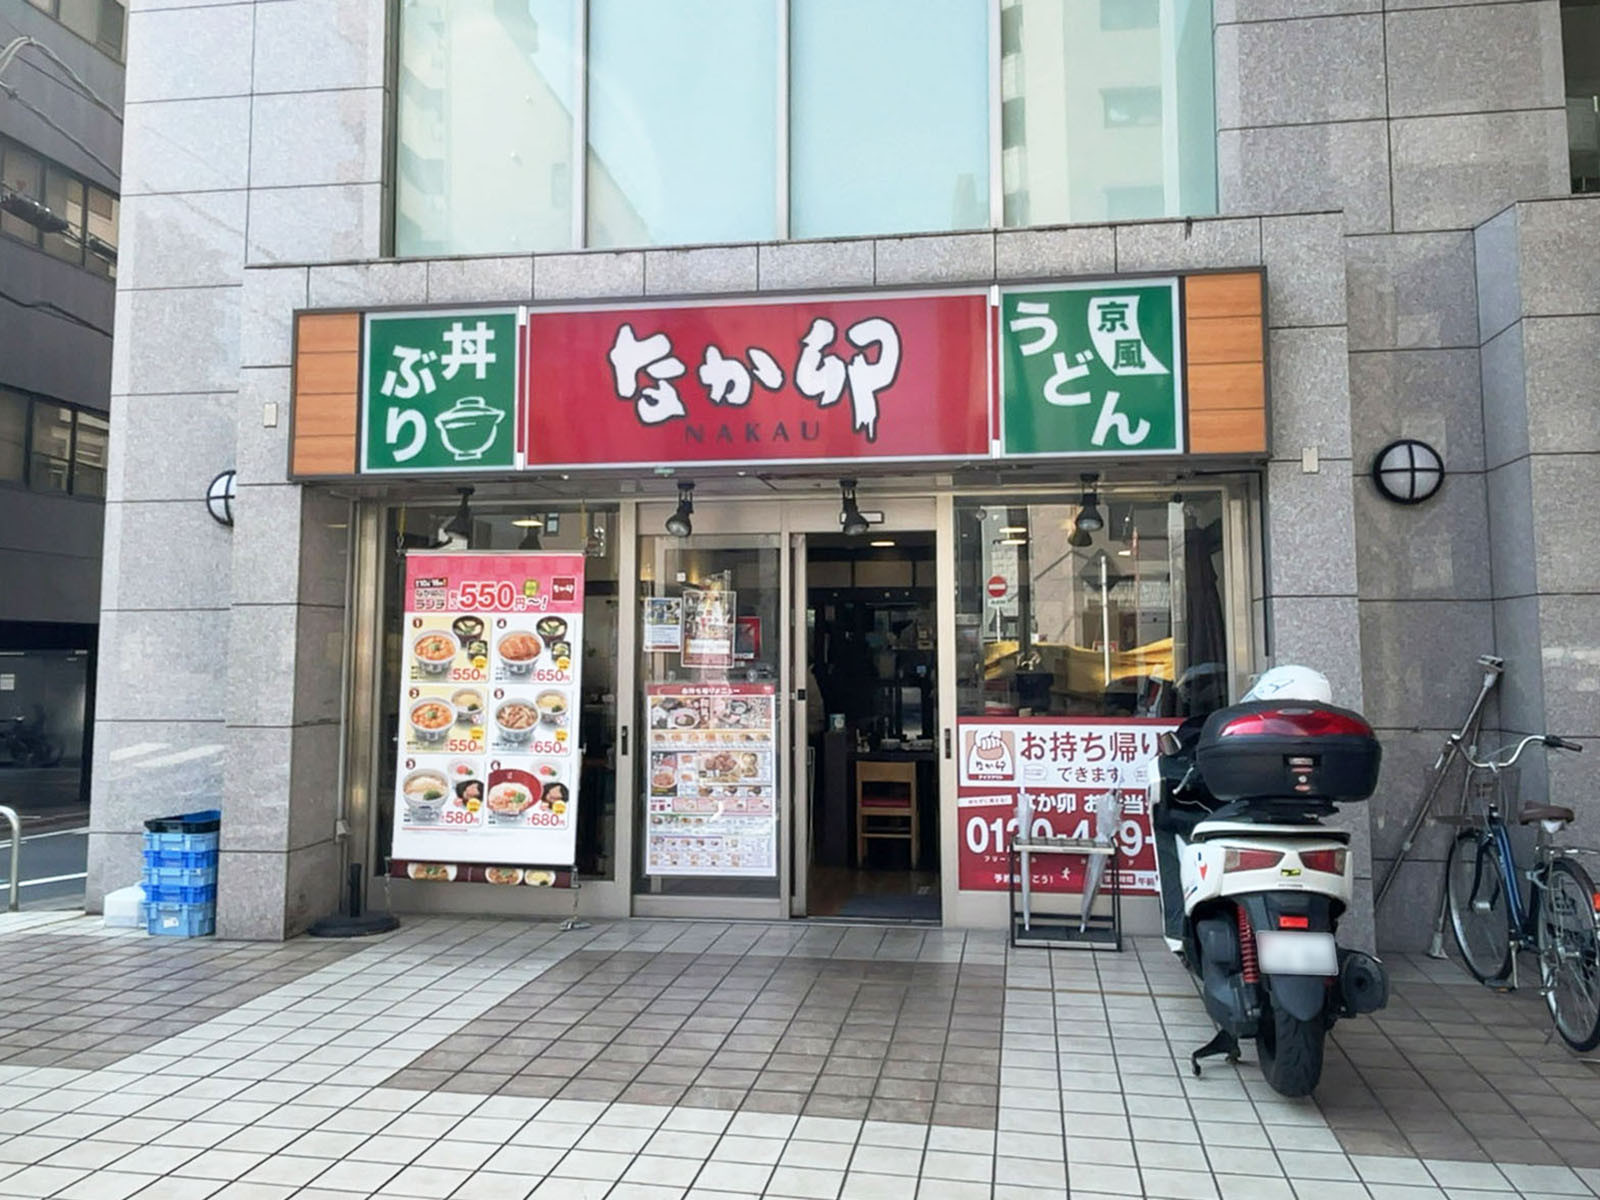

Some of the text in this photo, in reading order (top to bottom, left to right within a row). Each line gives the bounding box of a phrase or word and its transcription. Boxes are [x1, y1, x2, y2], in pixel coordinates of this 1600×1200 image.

[1097, 301, 1146, 369] 京風
[380, 321, 497, 462] 丼ぶり
[608, 316, 902, 442] なか卯
[1010, 301, 1150, 446] うどん
[684, 420, 820, 443] NAKAU
[1020, 731, 1161, 763] お持ち帰り
[1056, 767, 1119, 783] できます
[1083, 794, 1150, 815] お当
[966, 816, 1156, 857] 010-49-
